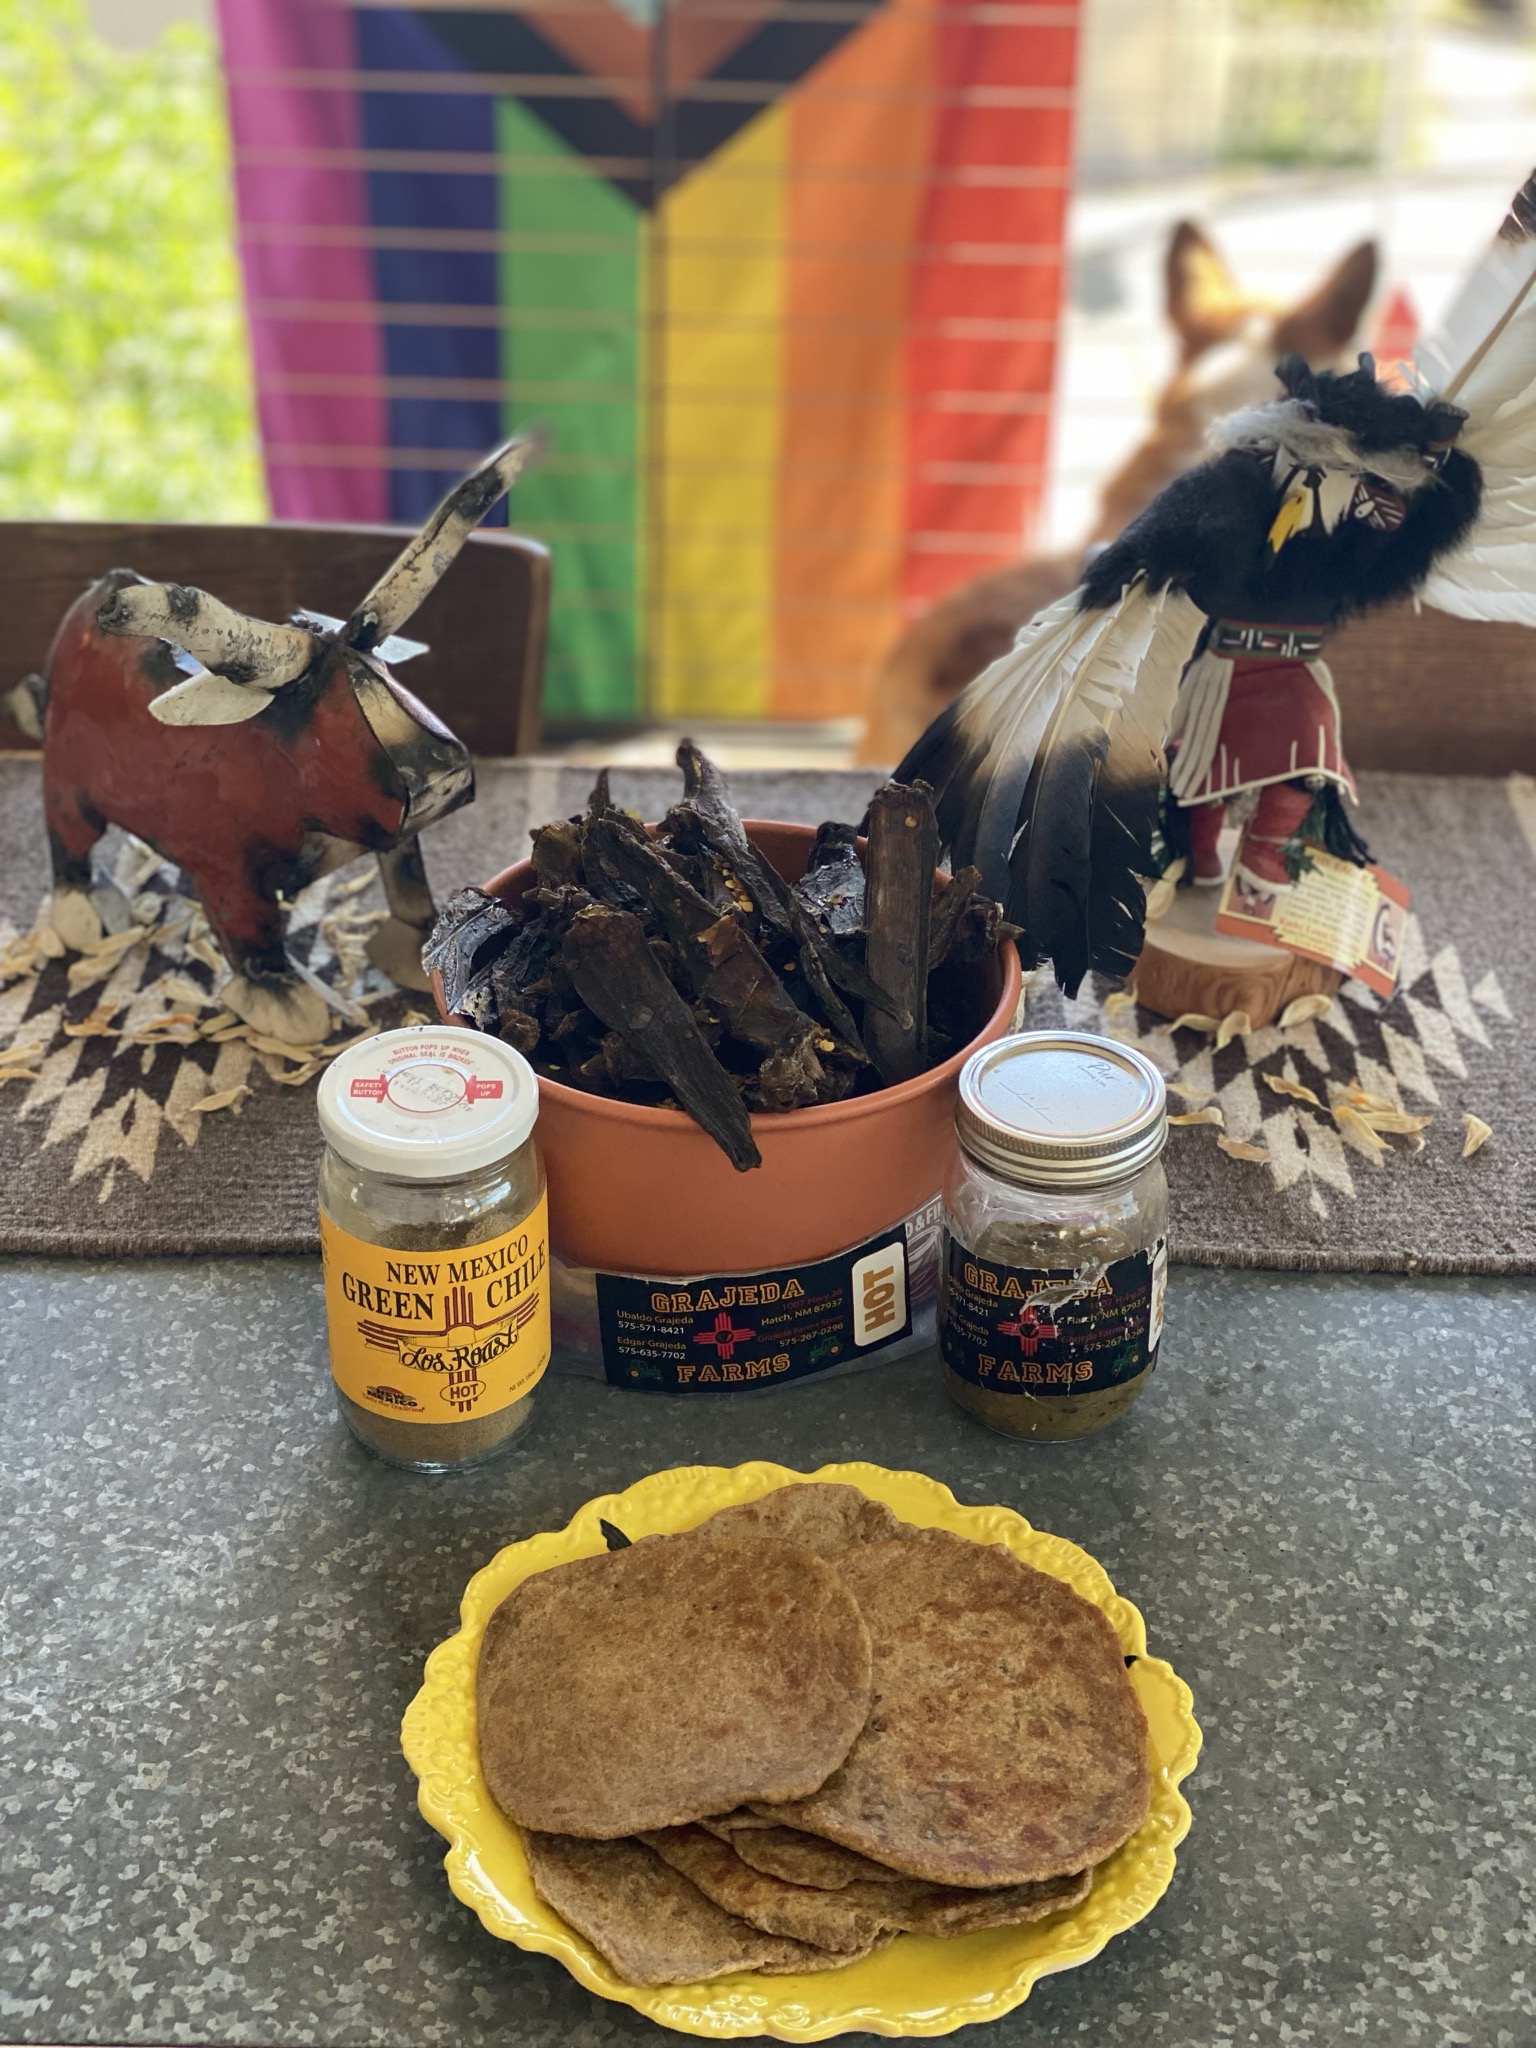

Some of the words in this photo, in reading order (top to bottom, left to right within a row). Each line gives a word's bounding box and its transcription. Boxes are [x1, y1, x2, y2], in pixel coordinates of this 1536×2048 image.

[388, 1053, 418, 1065] ORIGINAL
[392, 1045, 419, 1055] BUTTON
[452, 1046, 471, 1056] WHEN
[353, 1088, 383, 1096] BUTTON
[355, 1081, 383, 1089] SAFETY
[386, 1261, 440, 1286] NEW
[448, 1234, 528, 1283] MEXICO
[342, 1271, 434, 1320] GREEN
[486, 1238, 546, 1309] CHILE
[651, 1279, 805, 1313] GRAJEDA
[862, 1266, 895, 1332] HOT
[616, 1310, 653, 1322] Ubaldo
[655, 1316, 694, 1325] Grajeda
[761, 1314, 793, 1326] Hatch,
[795, 1307, 812, 1318] NM
[814, 1298, 843, 1313] 87937
[1102, 1308, 1119, 1320] NM
[1121, 1297, 1146, 1315] 87937
[618, 1320, 684, 1334] 575-571-8421
[780, 1322, 844, 1348] 575-267-0296
[447, 1325, 519, 1370] Roast
[617, 1336, 645, 1347] Edgar
[647, 1339, 687, 1350] Grajeda
[618, 1346, 686, 1359] 575-635-7702
[677, 1353, 791, 1383] FARMS
[978, 1353, 1094, 1384] FARMS
[450, 1383, 479, 1400] HOT
